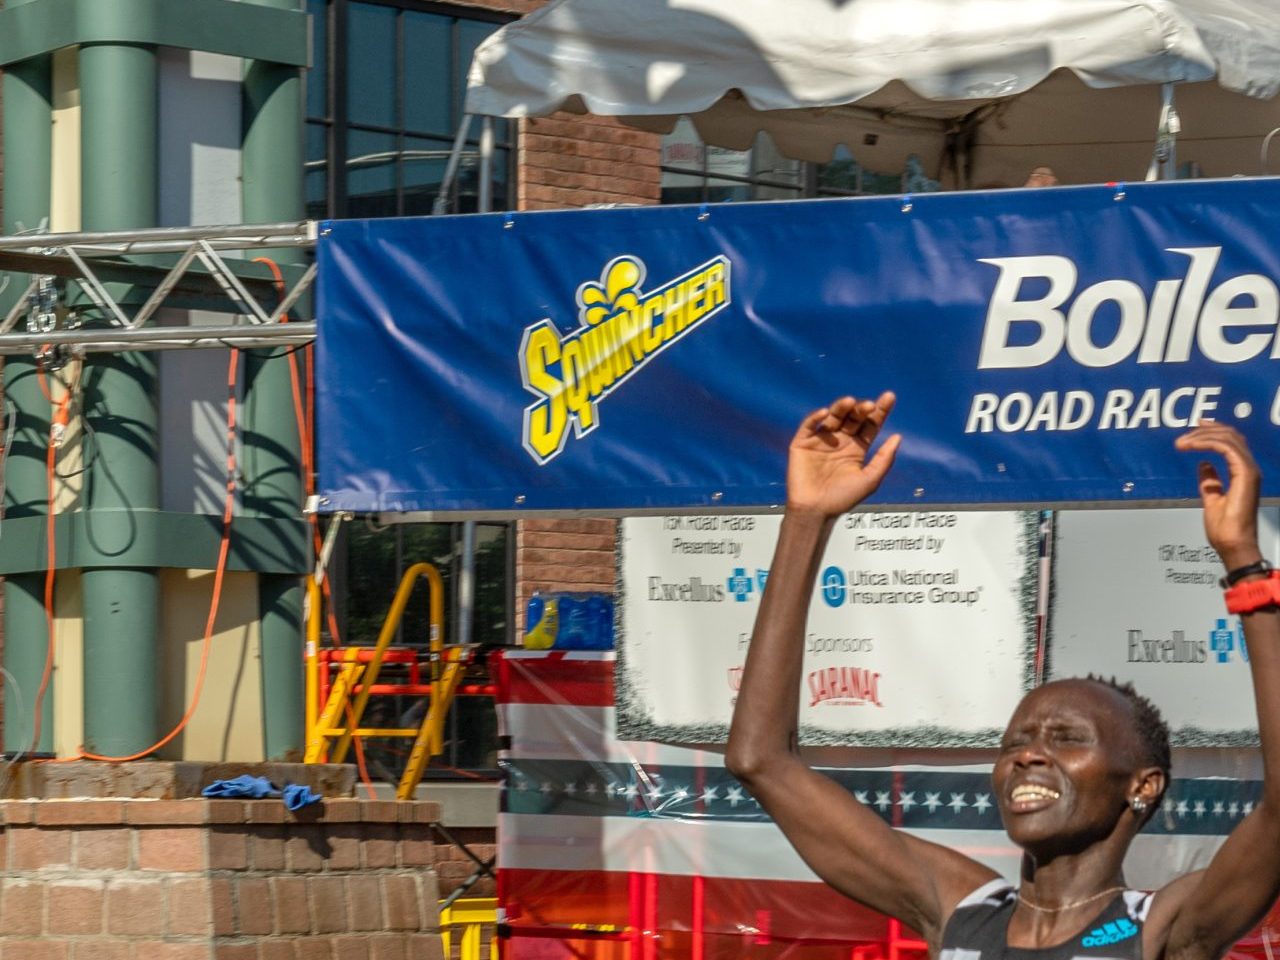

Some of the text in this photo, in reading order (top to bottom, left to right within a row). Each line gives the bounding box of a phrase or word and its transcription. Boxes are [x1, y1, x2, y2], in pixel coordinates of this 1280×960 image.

[964, 391, 1094, 433] ROAD
[1099, 386, 1220, 428] RACE
[914, 512, 957, 528] Race
[854, 535, 945, 553] Presented by
[850, 569, 959, 586] Utica National
[648, 576, 724, 602] Excellus
[850, 589, 925, 604] Insurance
[1126, 629, 1208, 663] Excellus
[808, 667, 883, 707] SARANAC
